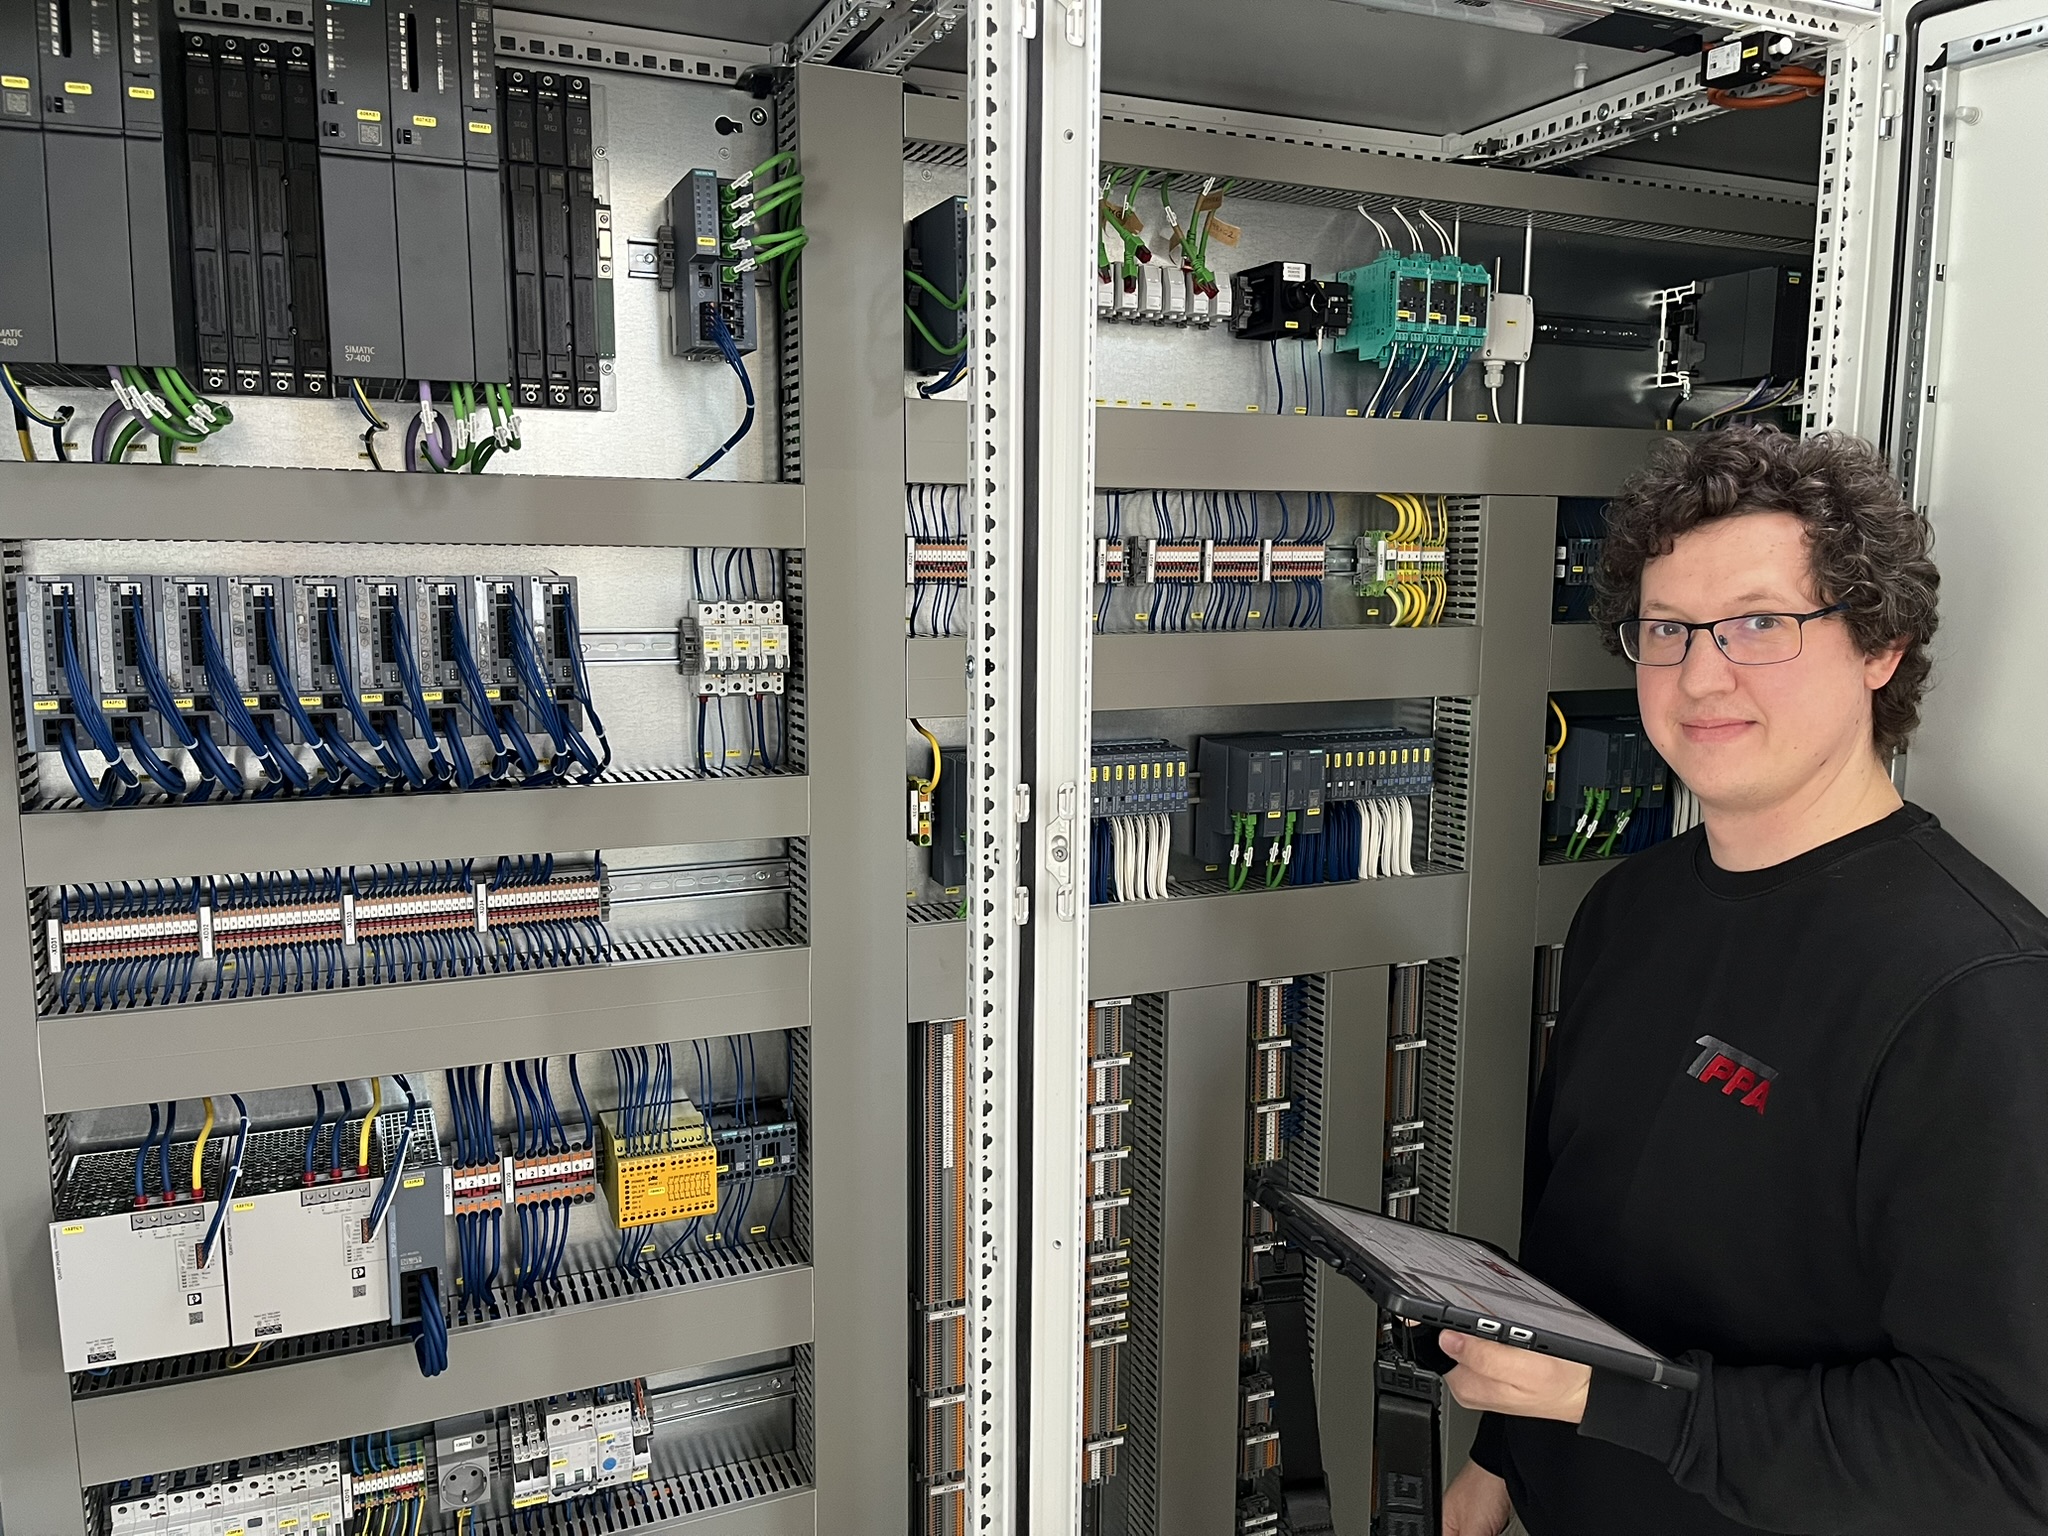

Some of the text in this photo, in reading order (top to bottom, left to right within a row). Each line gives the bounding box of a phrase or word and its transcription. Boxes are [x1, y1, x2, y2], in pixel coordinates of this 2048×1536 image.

[0, 328, 23, 338] MATIC
[0, 337, 19, 346] -400
[344, 344, 375, 355] SIMATIC
[345, 353, 371, 363] S7-400
[50, 937, 58, 956] -XD31
[1686, 1034, 1779, 1115] TPPA
